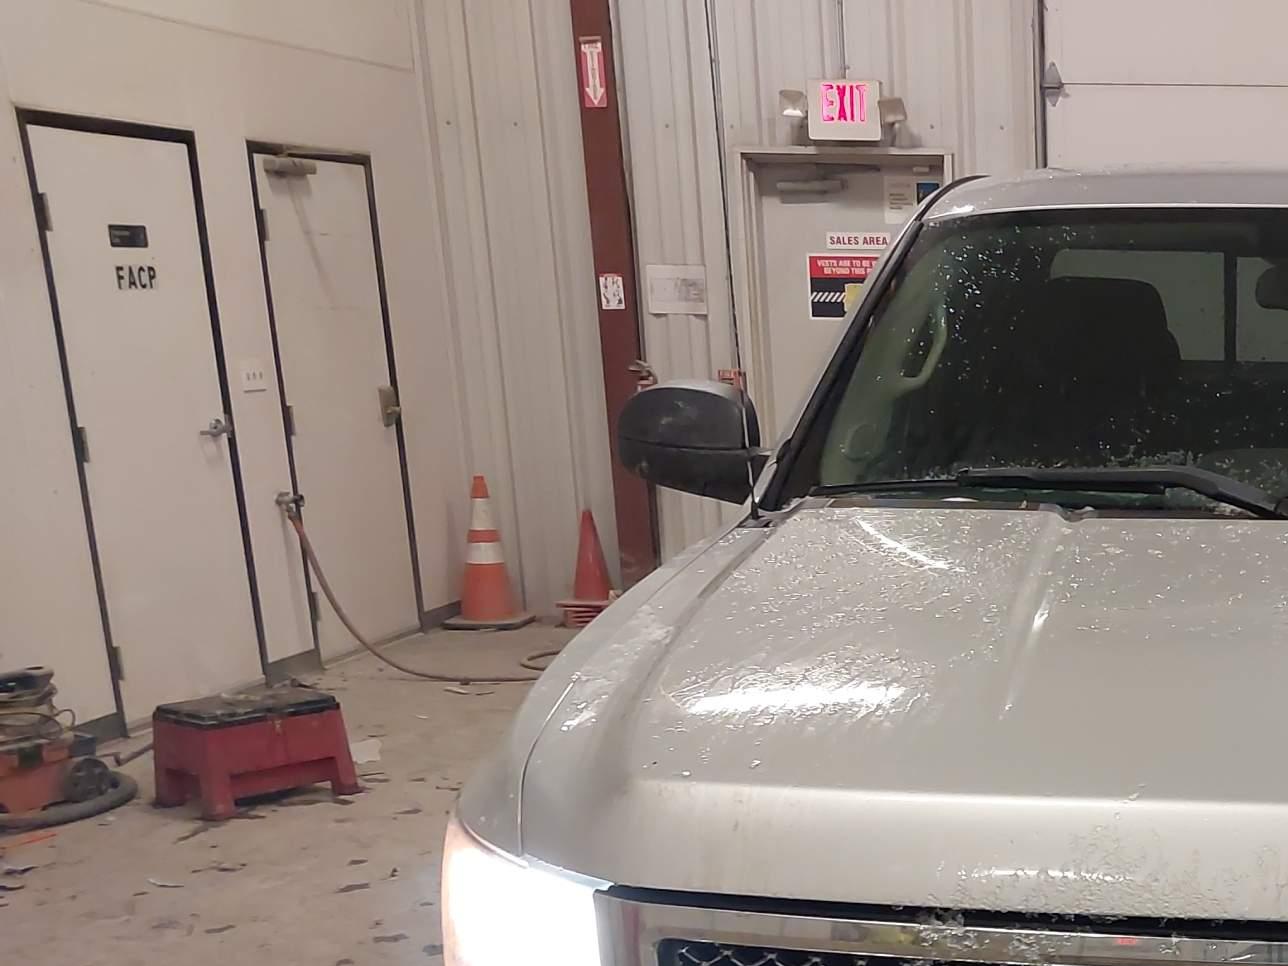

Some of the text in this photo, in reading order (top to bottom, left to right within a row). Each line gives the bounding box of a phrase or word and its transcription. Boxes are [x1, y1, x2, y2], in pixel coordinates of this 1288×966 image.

[821, 84, 866, 122] EXIT
[829, 236, 888, 246] SALES AREA
[115, 265, 156, 290] FACP
[823, 267, 850, 275] BEYOND
